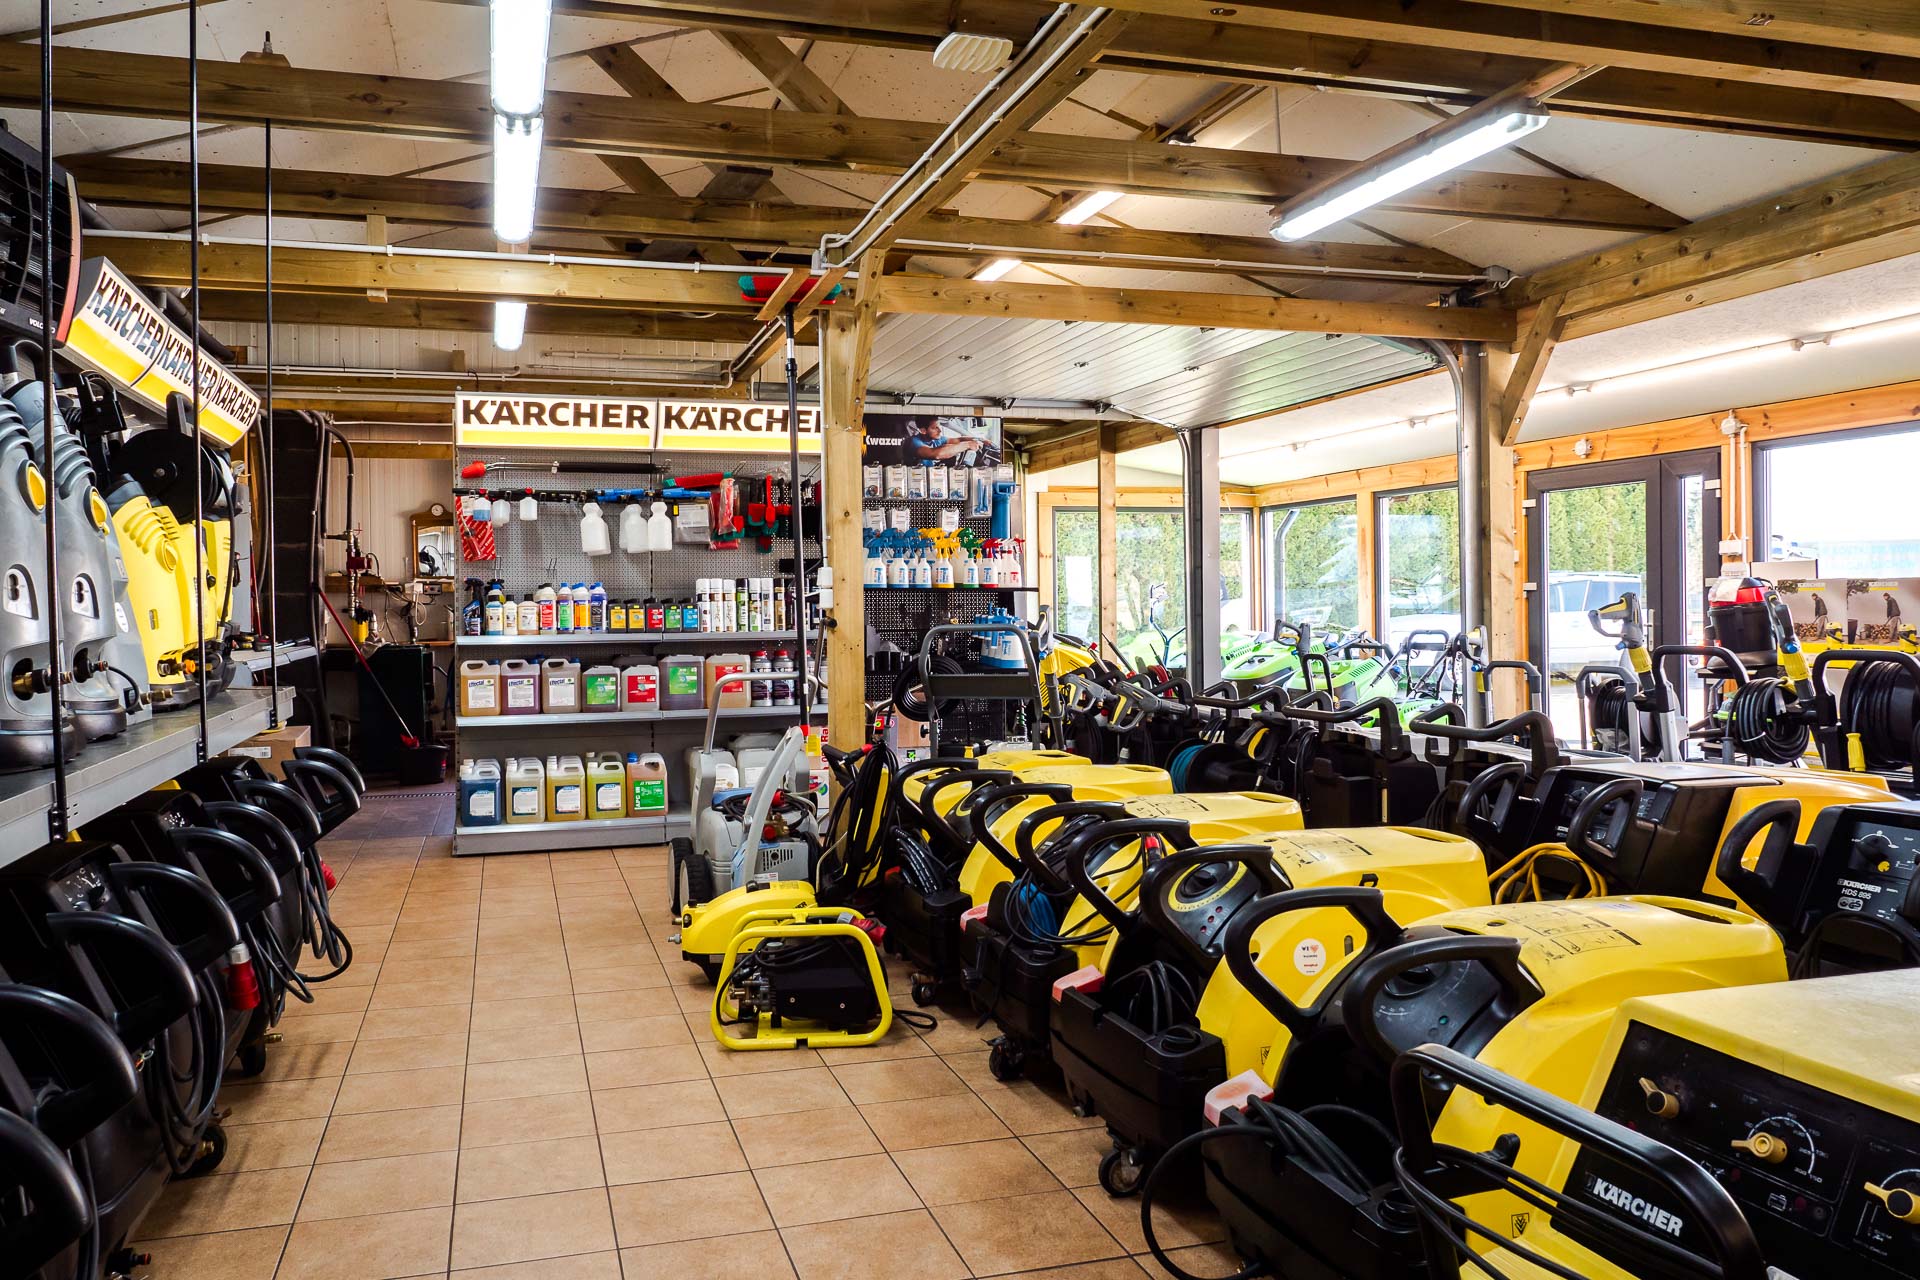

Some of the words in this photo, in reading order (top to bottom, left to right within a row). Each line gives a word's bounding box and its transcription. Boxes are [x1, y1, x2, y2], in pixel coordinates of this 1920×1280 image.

[87, 271, 165, 361] KÄRCHER
[214, 375, 257, 427] KÄRCHER
[462, 399, 650, 429] KÄRCHER
[664, 405, 821, 433] KÄRCHE
[1841, 888, 1858, 897] HDS
[1858, 891, 1872, 900] 895
[1592, 1177, 1684, 1237] KÄRCHER
